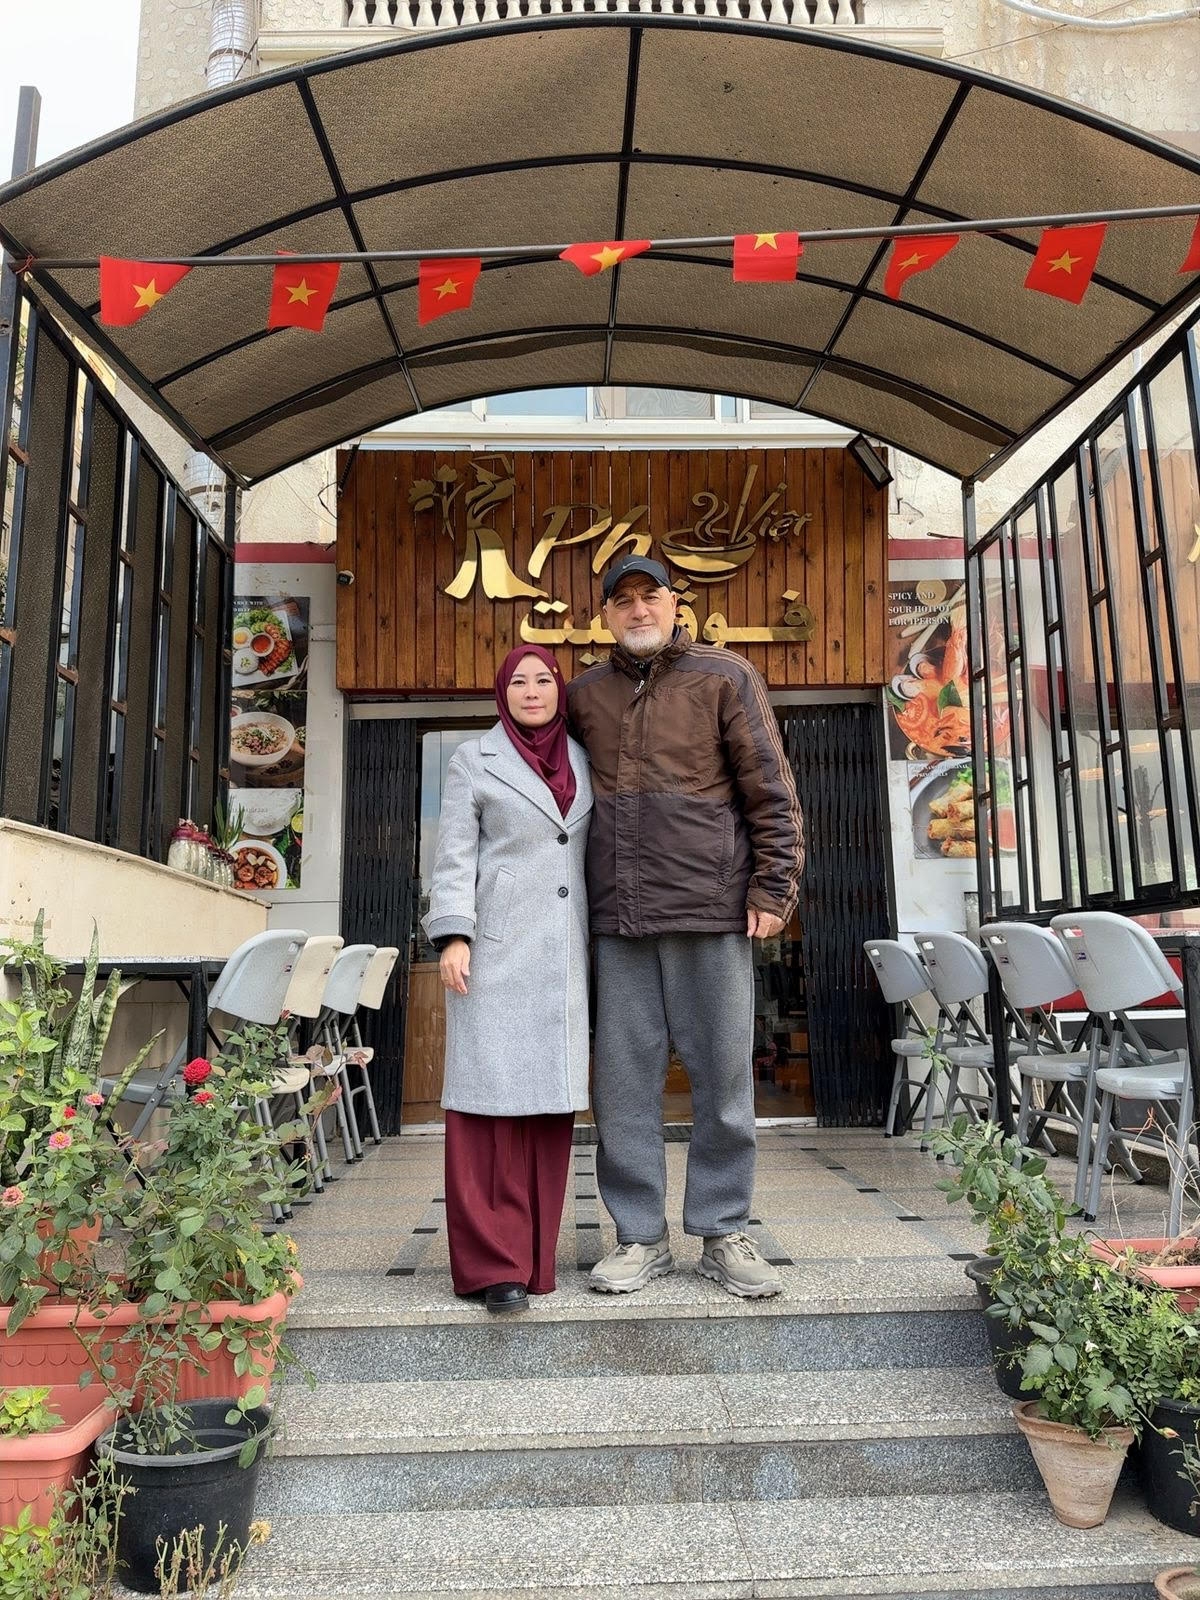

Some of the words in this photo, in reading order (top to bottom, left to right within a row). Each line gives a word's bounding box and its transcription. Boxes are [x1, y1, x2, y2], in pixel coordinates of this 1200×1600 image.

[888, 592, 912, 600] SPICY
[915, 591, 935, 600] AND
[888, 605, 912, 614] SOUR
[914, 604, 951, 613] HOTPOT
[889, 618, 907, 626] FOR
